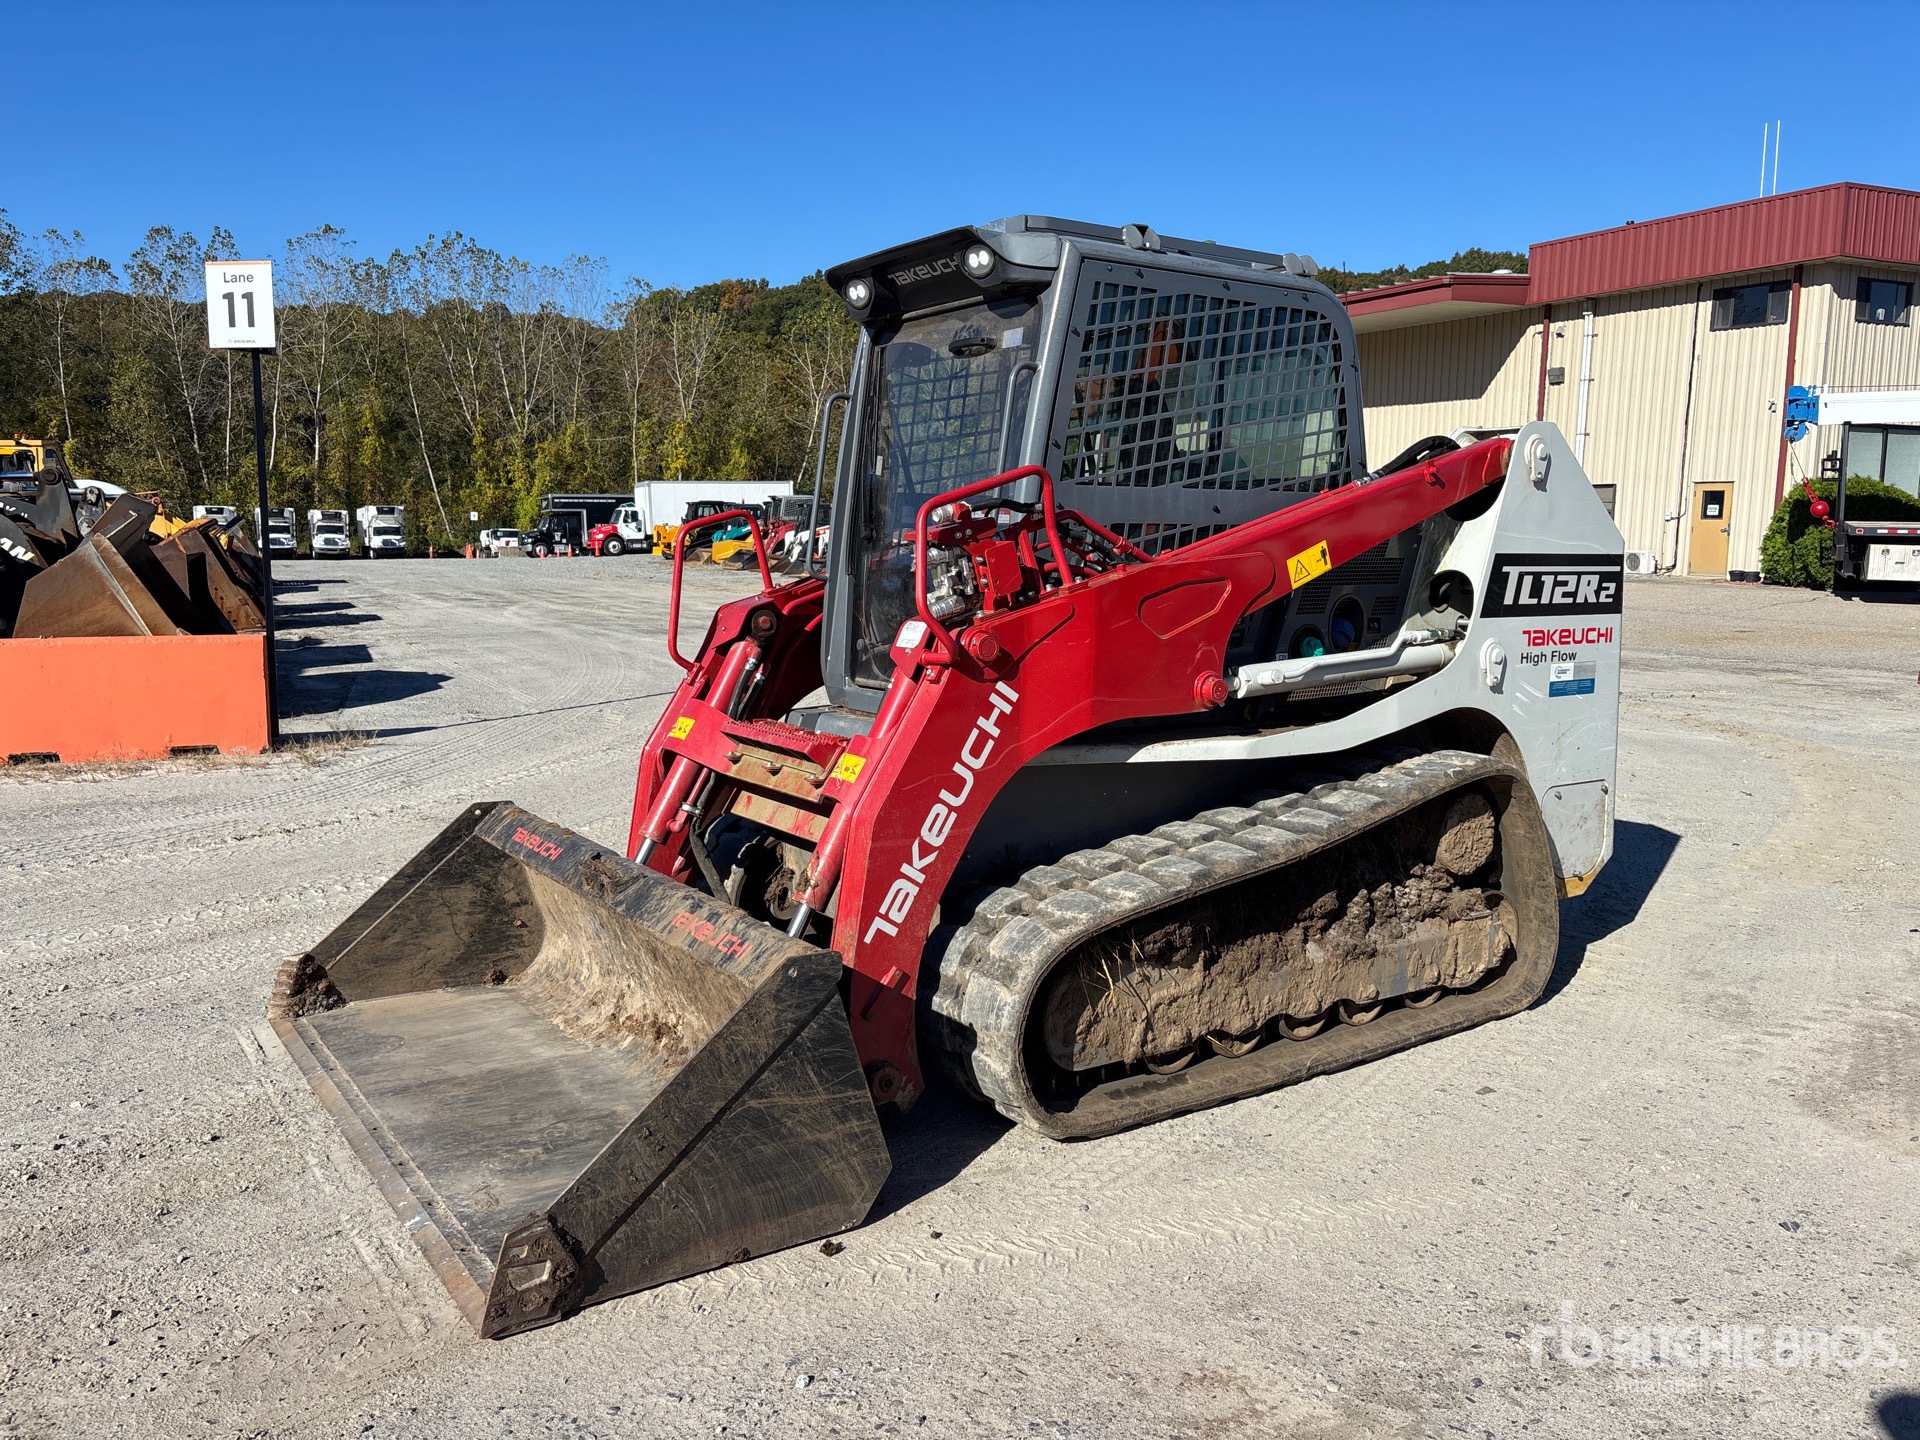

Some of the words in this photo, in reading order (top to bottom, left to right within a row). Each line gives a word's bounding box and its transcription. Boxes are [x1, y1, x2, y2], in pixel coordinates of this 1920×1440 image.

[223, 272, 254, 283] Lane
[887, 257, 959, 286] TAKEUCH
[222, 291, 255, 328] 11
[1522, 627, 1613, 647] TAKEUCHI
[1520, 651, 1547, 666] High
[1550, 650, 1577, 663] Flow
[863, 680, 1020, 944] TAKEUCHI
[511, 826, 564, 861] TAKEUCHI
[671, 908, 753, 959] TAKEUCHI
